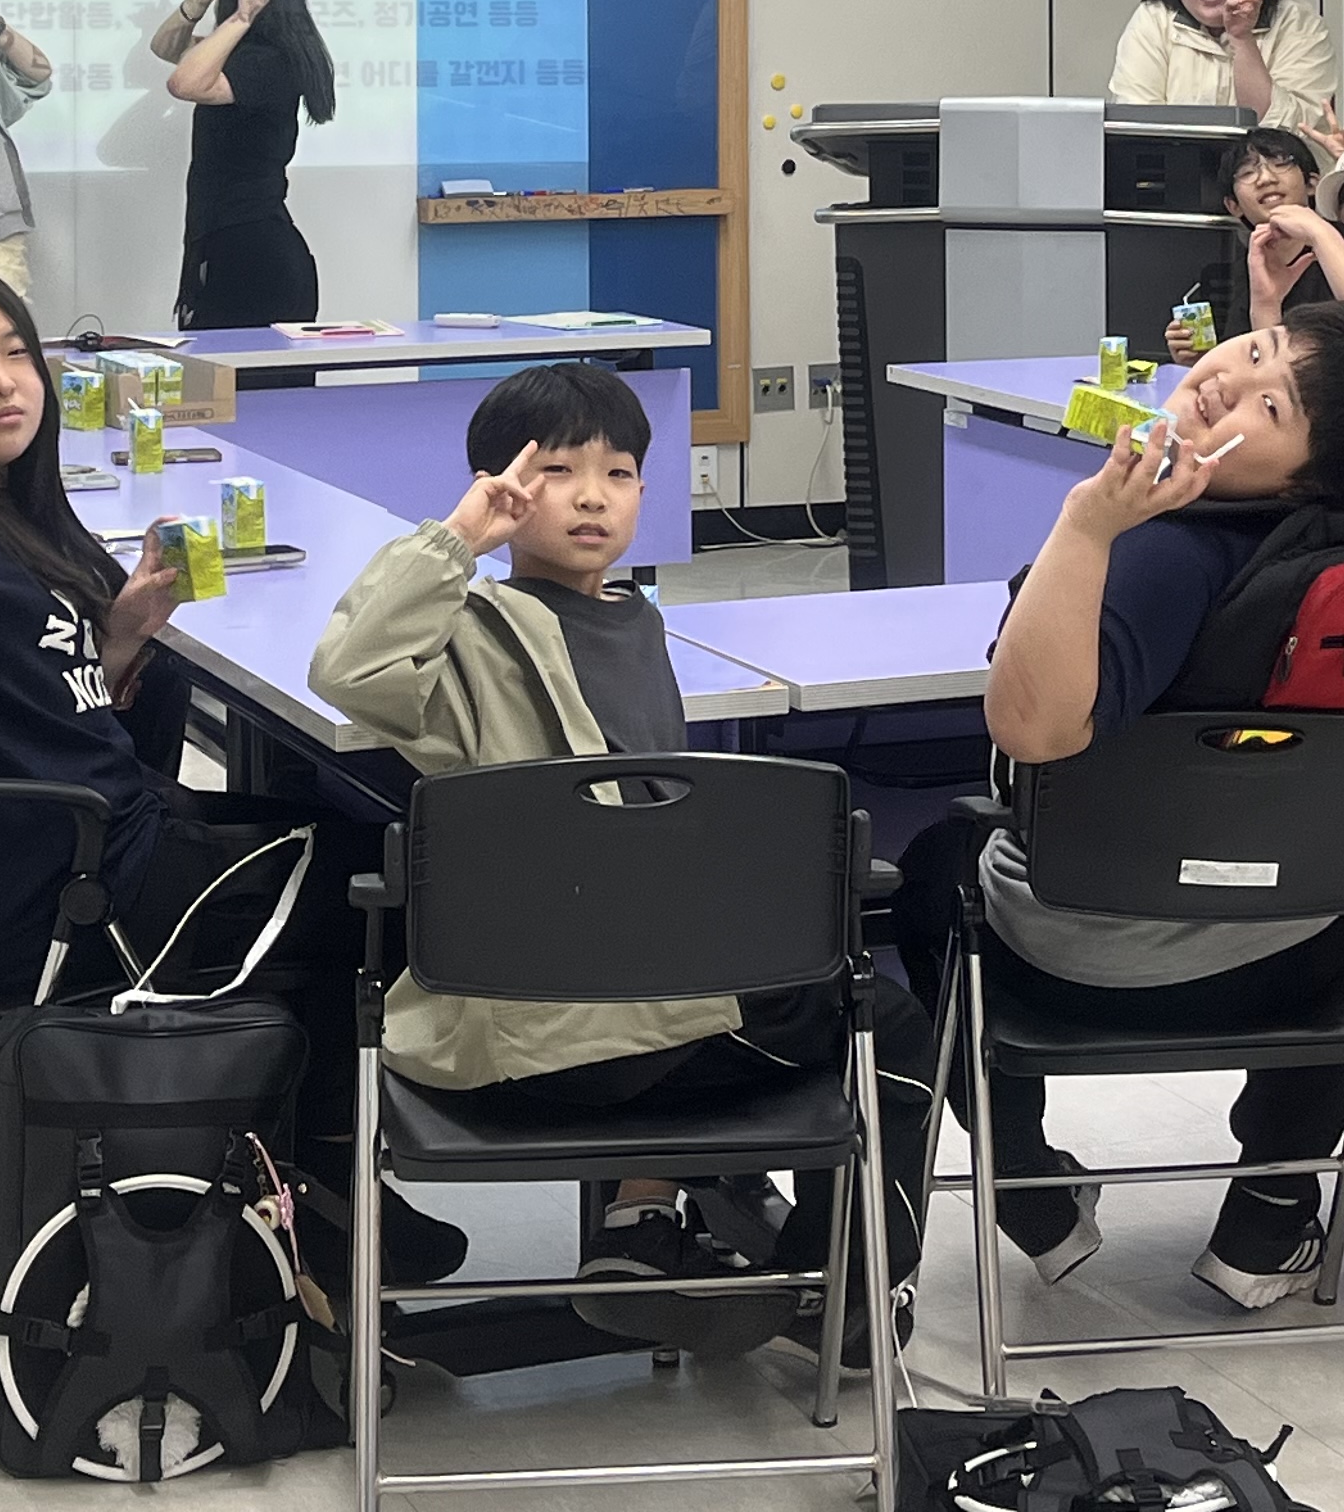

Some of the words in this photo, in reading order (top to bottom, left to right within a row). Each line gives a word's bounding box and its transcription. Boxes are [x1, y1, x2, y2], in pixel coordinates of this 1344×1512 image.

[374, 0, 478, 28] 정기공연
[362, 59, 438, 88] 어디를
[449, 58, 525, 87] 갈껀지
